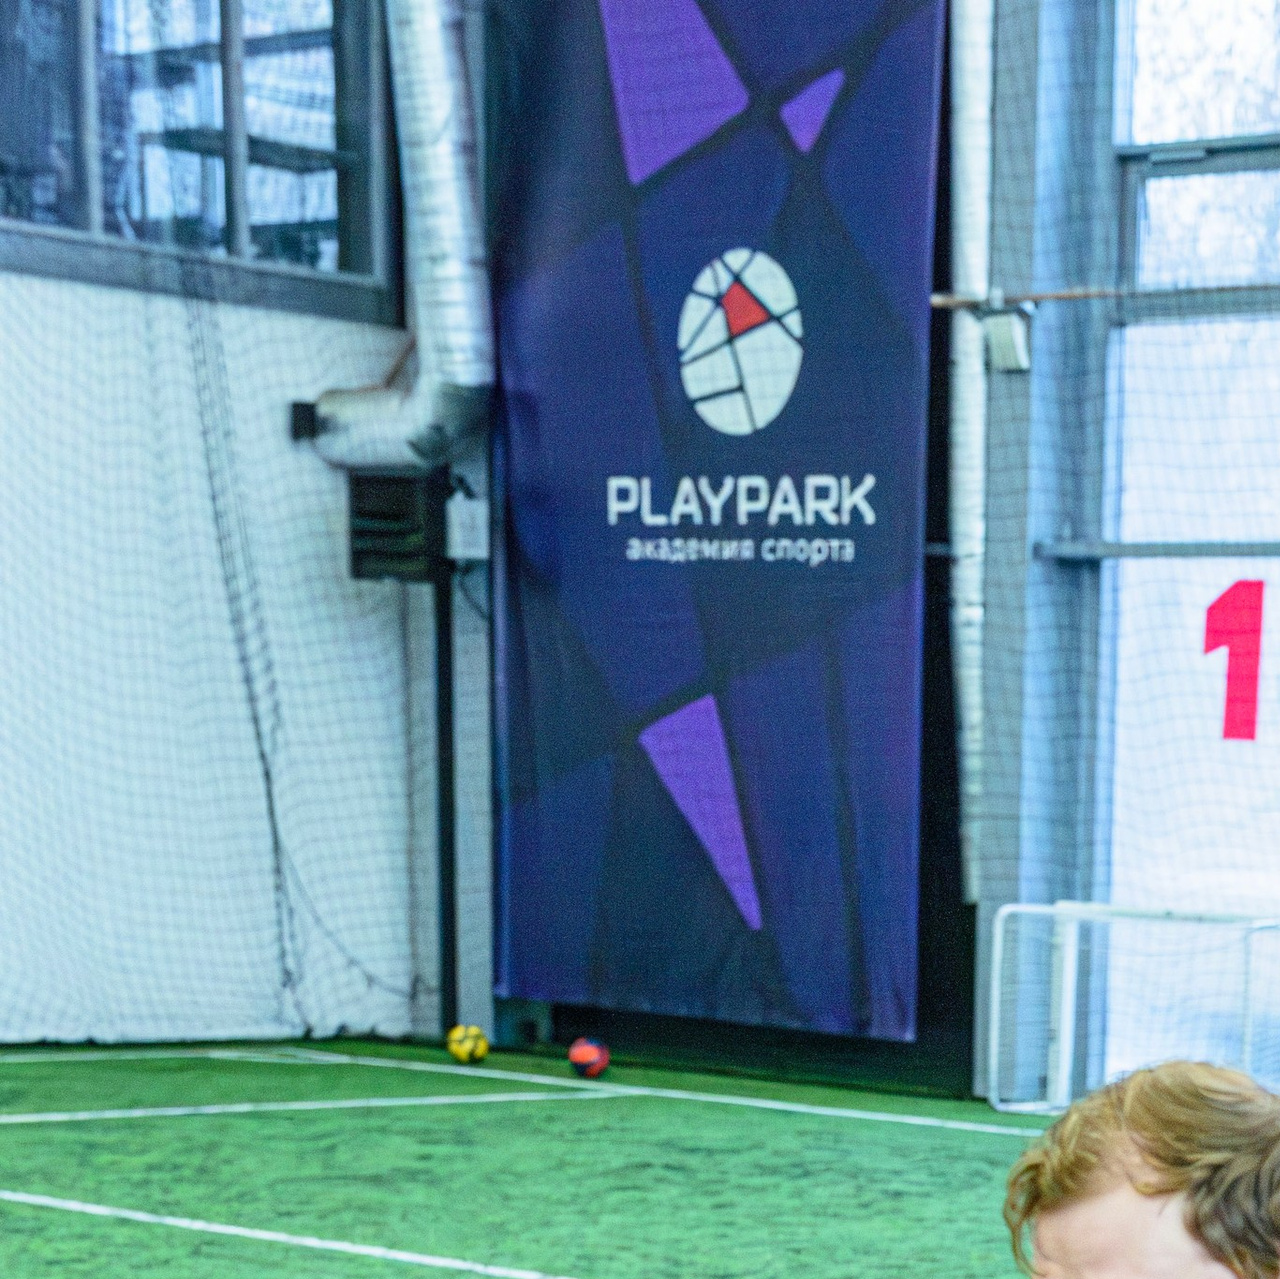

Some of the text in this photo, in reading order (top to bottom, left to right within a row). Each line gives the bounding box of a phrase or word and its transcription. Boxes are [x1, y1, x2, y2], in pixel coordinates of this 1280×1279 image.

[606, 474, 876, 526] PLAYPARK
[626, 537, 855, 567] академия спорта
[1203, 579, 1265, 741] 1
